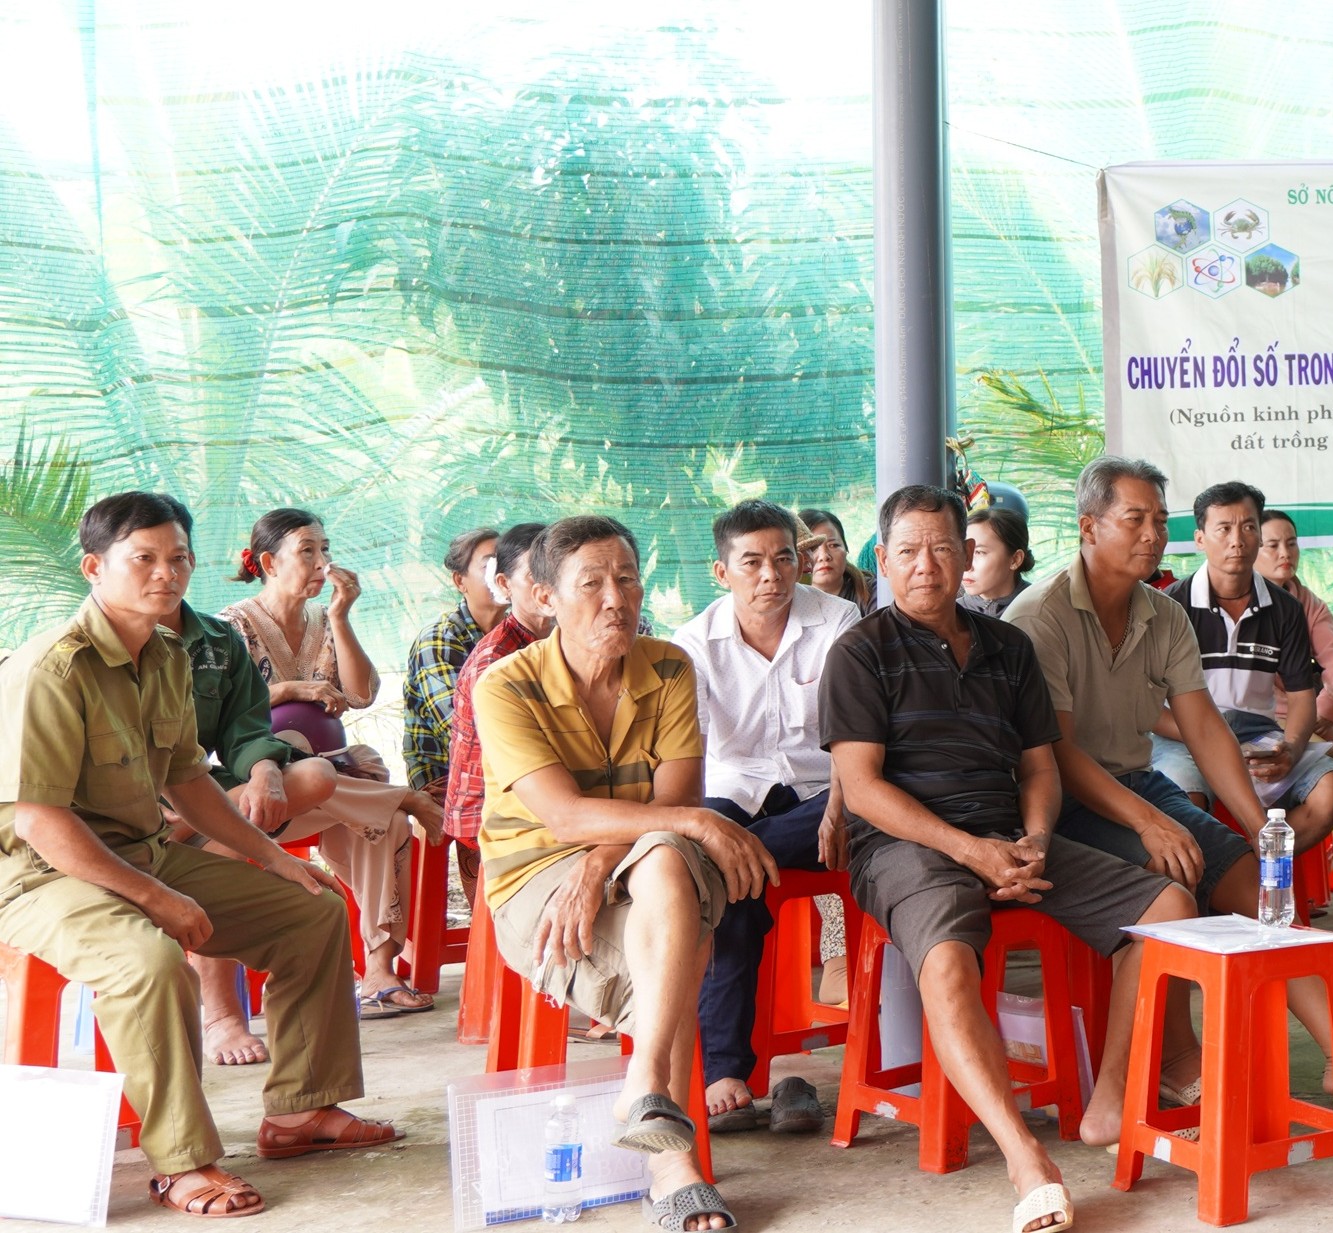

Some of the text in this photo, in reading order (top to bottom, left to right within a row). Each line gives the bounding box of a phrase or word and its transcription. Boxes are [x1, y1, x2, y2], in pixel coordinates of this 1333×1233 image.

[1287, 183, 1309, 204] SỞ
[1127, 338, 1206, 390] CHUYỂN
[1212, 337, 1247, 388] ĐỔI
[1253, 340, 1280, 387] SỐ
[1169, 404, 1245, 428] (Nguồn
[1253, 405, 1300, 422] kinh
[1230, 432, 1265, 450] đất
[1272, 430, 1329, 451] trồng
